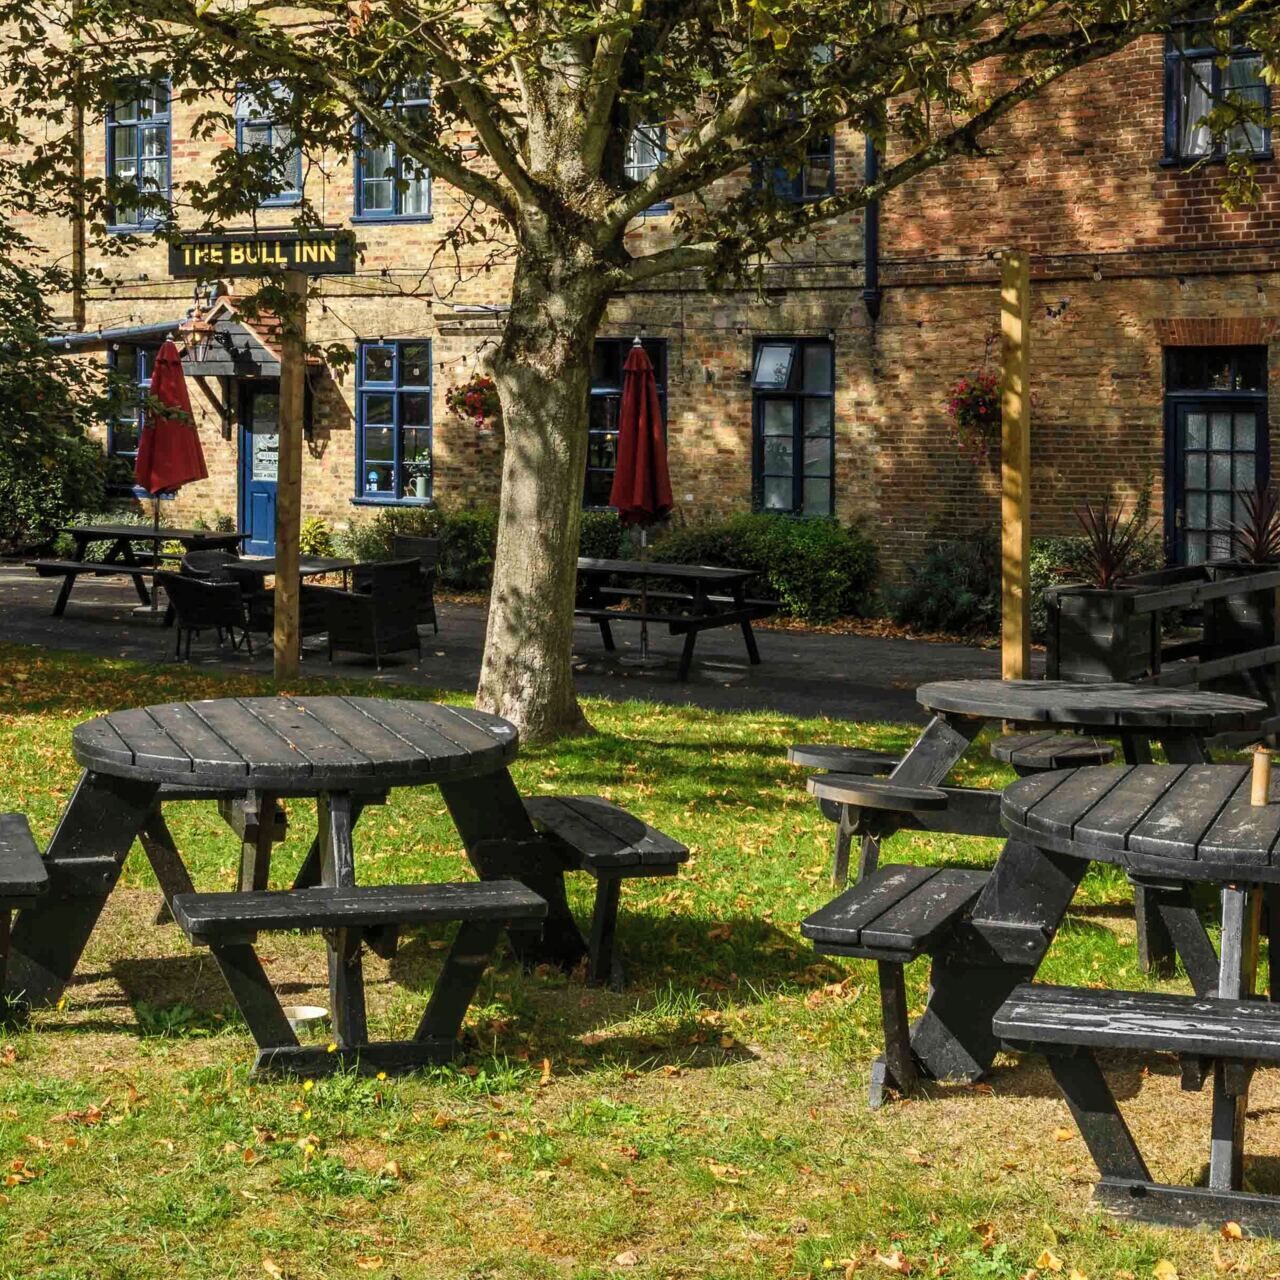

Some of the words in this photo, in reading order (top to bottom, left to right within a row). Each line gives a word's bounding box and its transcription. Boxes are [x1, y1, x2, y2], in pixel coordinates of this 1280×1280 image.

[181, 243, 223, 265] THE
[231, 242, 288, 264] BULL
[295, 240, 336, 262] INN
